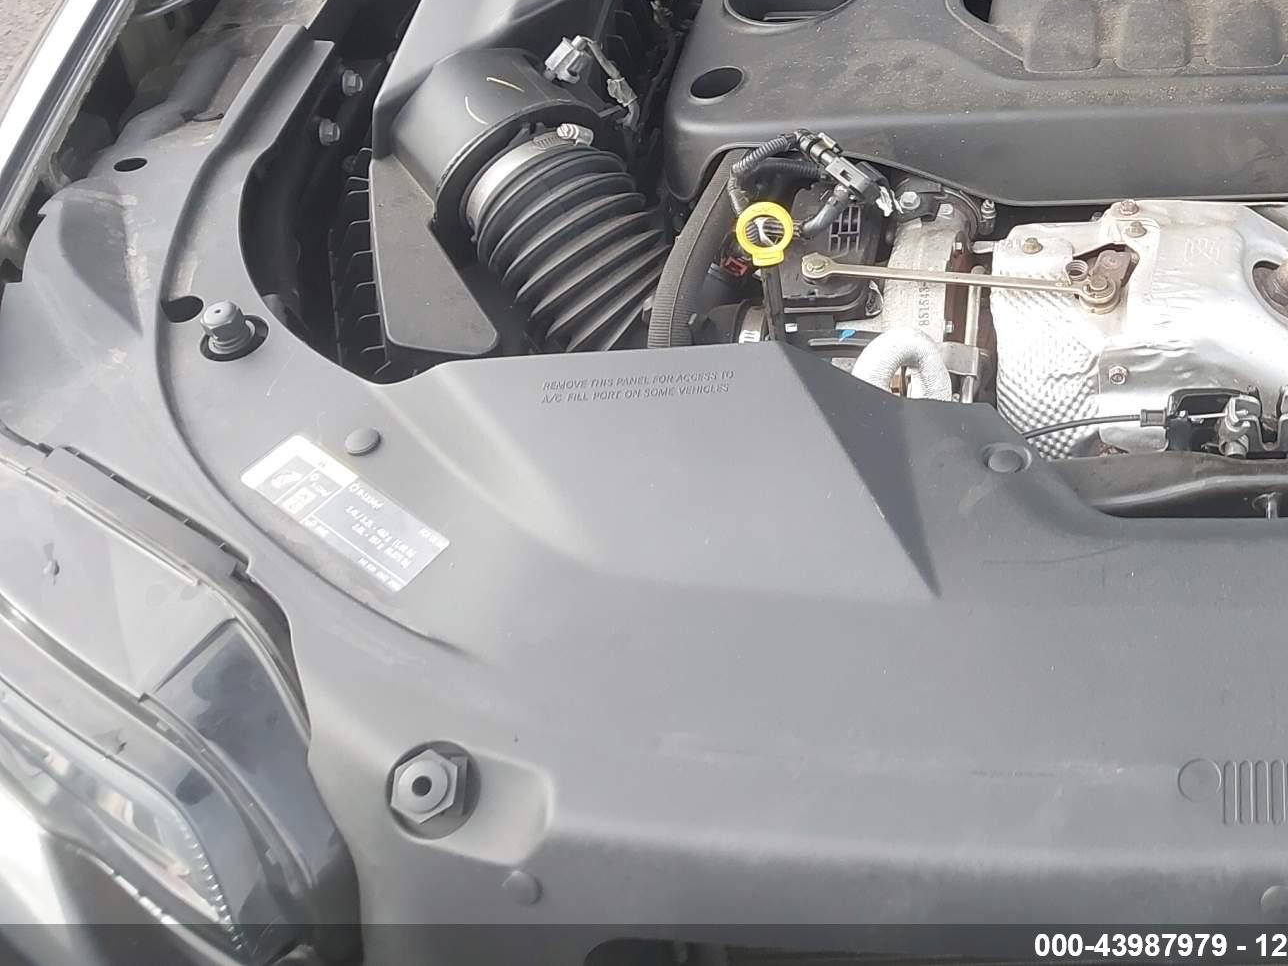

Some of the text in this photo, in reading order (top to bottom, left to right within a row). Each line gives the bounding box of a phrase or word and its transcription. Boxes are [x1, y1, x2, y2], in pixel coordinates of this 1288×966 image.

[543, 370, 735, 391] REMOVE THIS PANEL FOR ACCESS TO
[541, 383, 729, 404] A/C FILL PORT ON SOME VEHICLES
